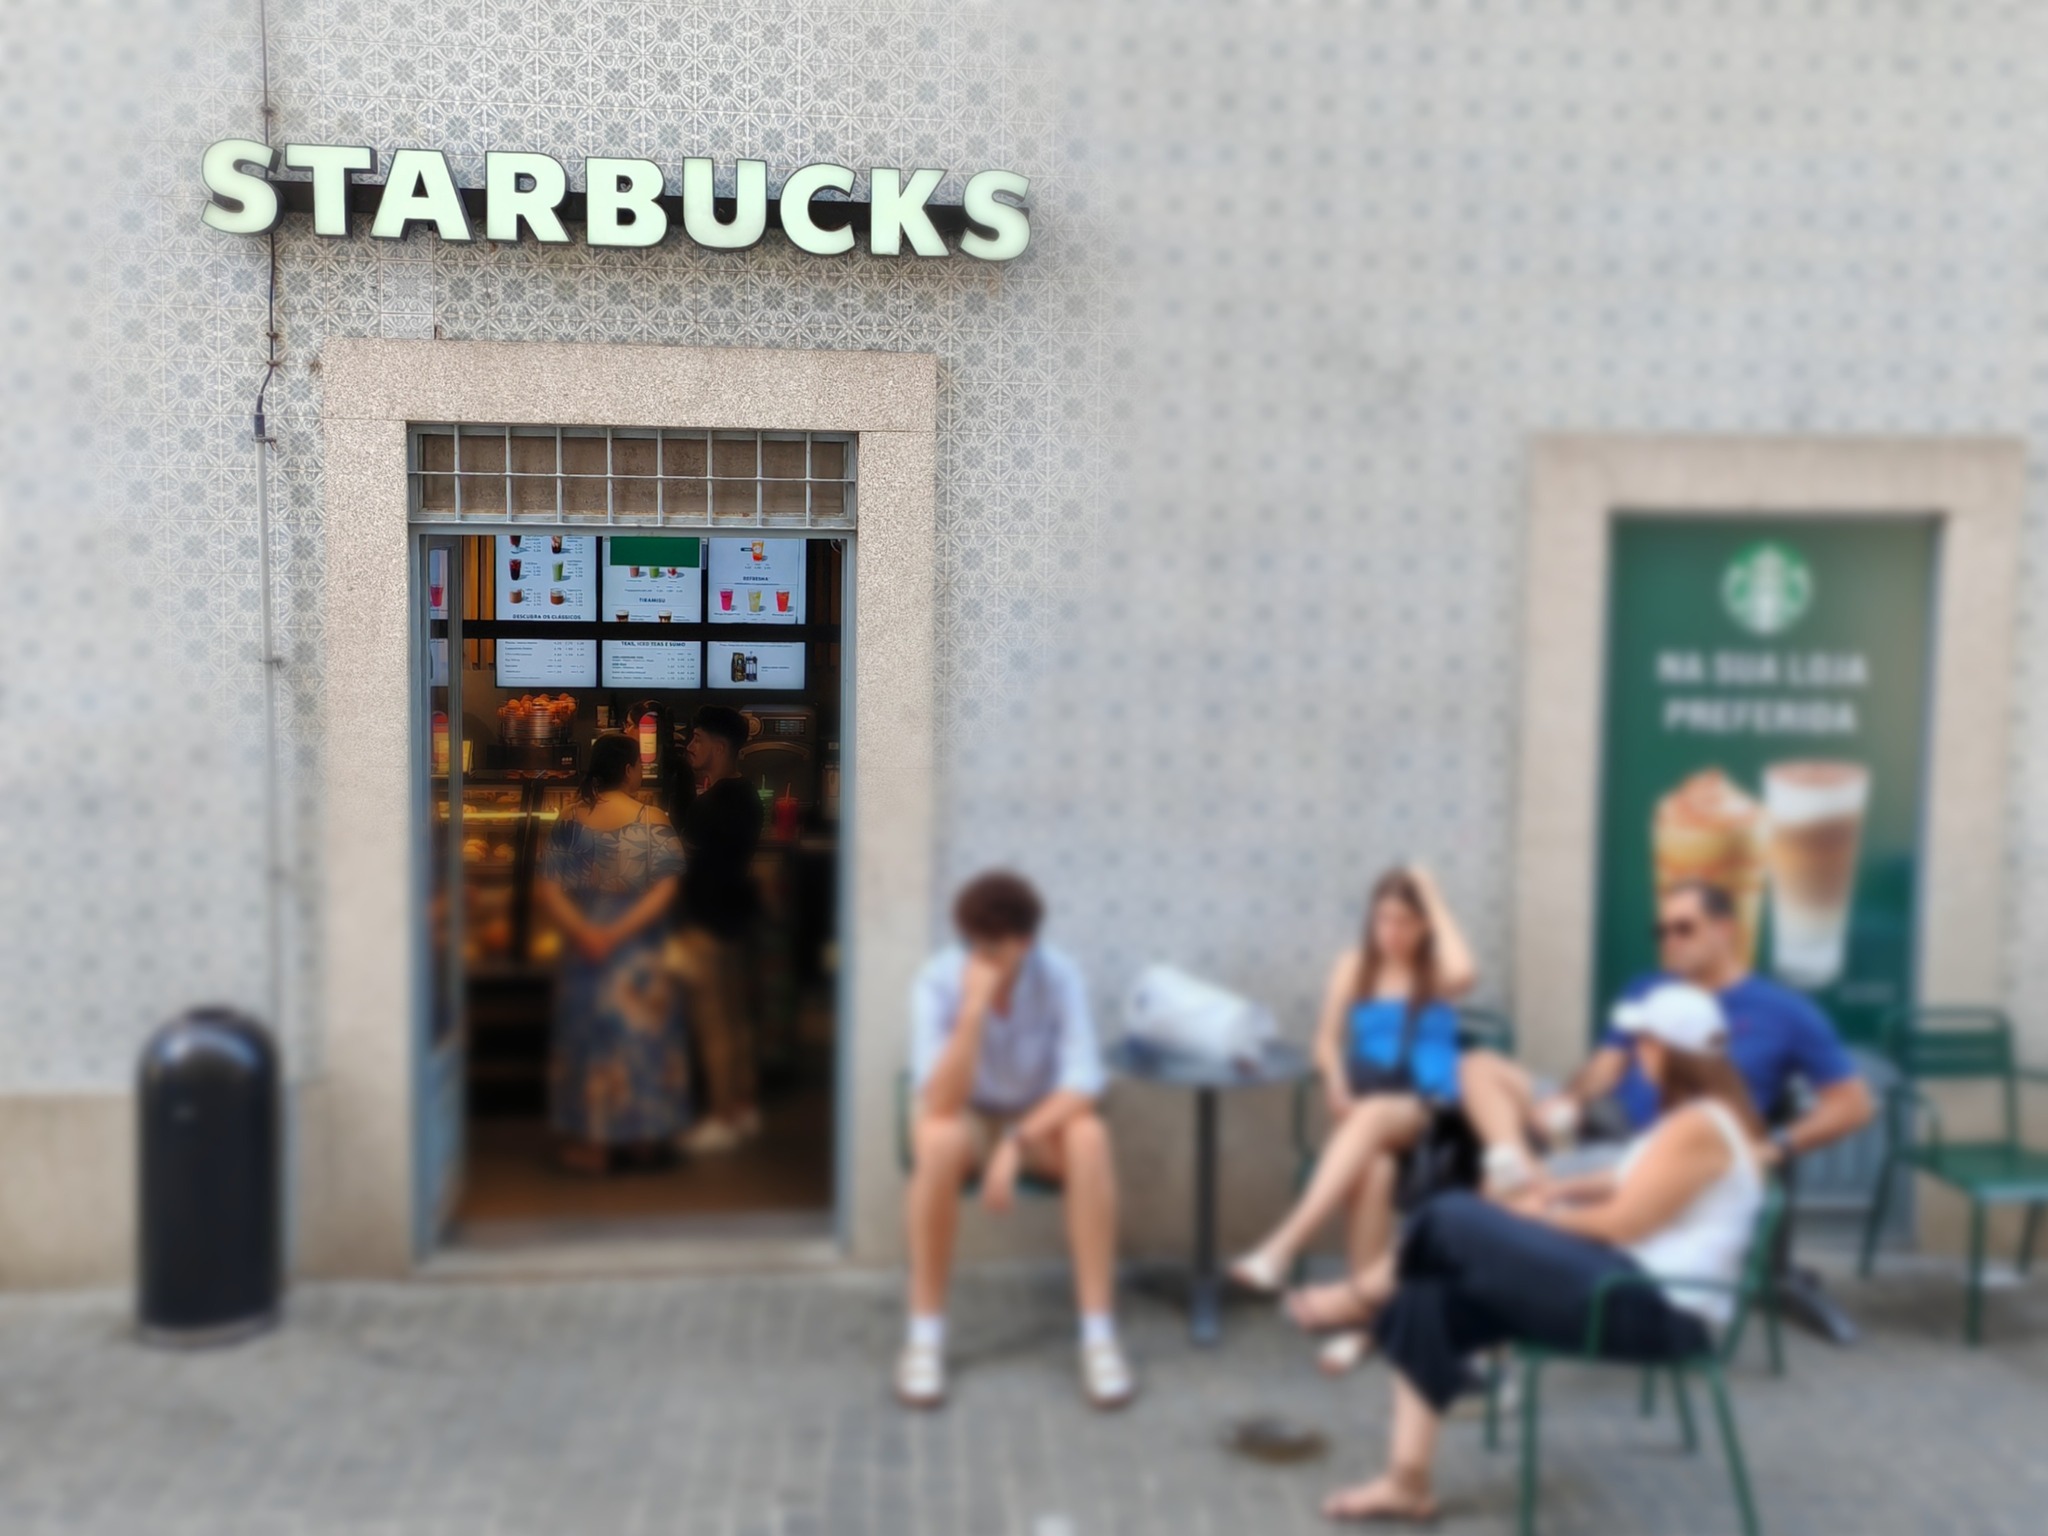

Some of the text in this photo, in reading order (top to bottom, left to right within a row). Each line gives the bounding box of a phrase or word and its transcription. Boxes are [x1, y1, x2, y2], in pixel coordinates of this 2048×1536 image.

[200, 138, 1032, 262] STARBUCKS
[1657, 652, 1868, 685] NA SUA LOJA
[1664, 700, 1856, 734] PREFERIDA
